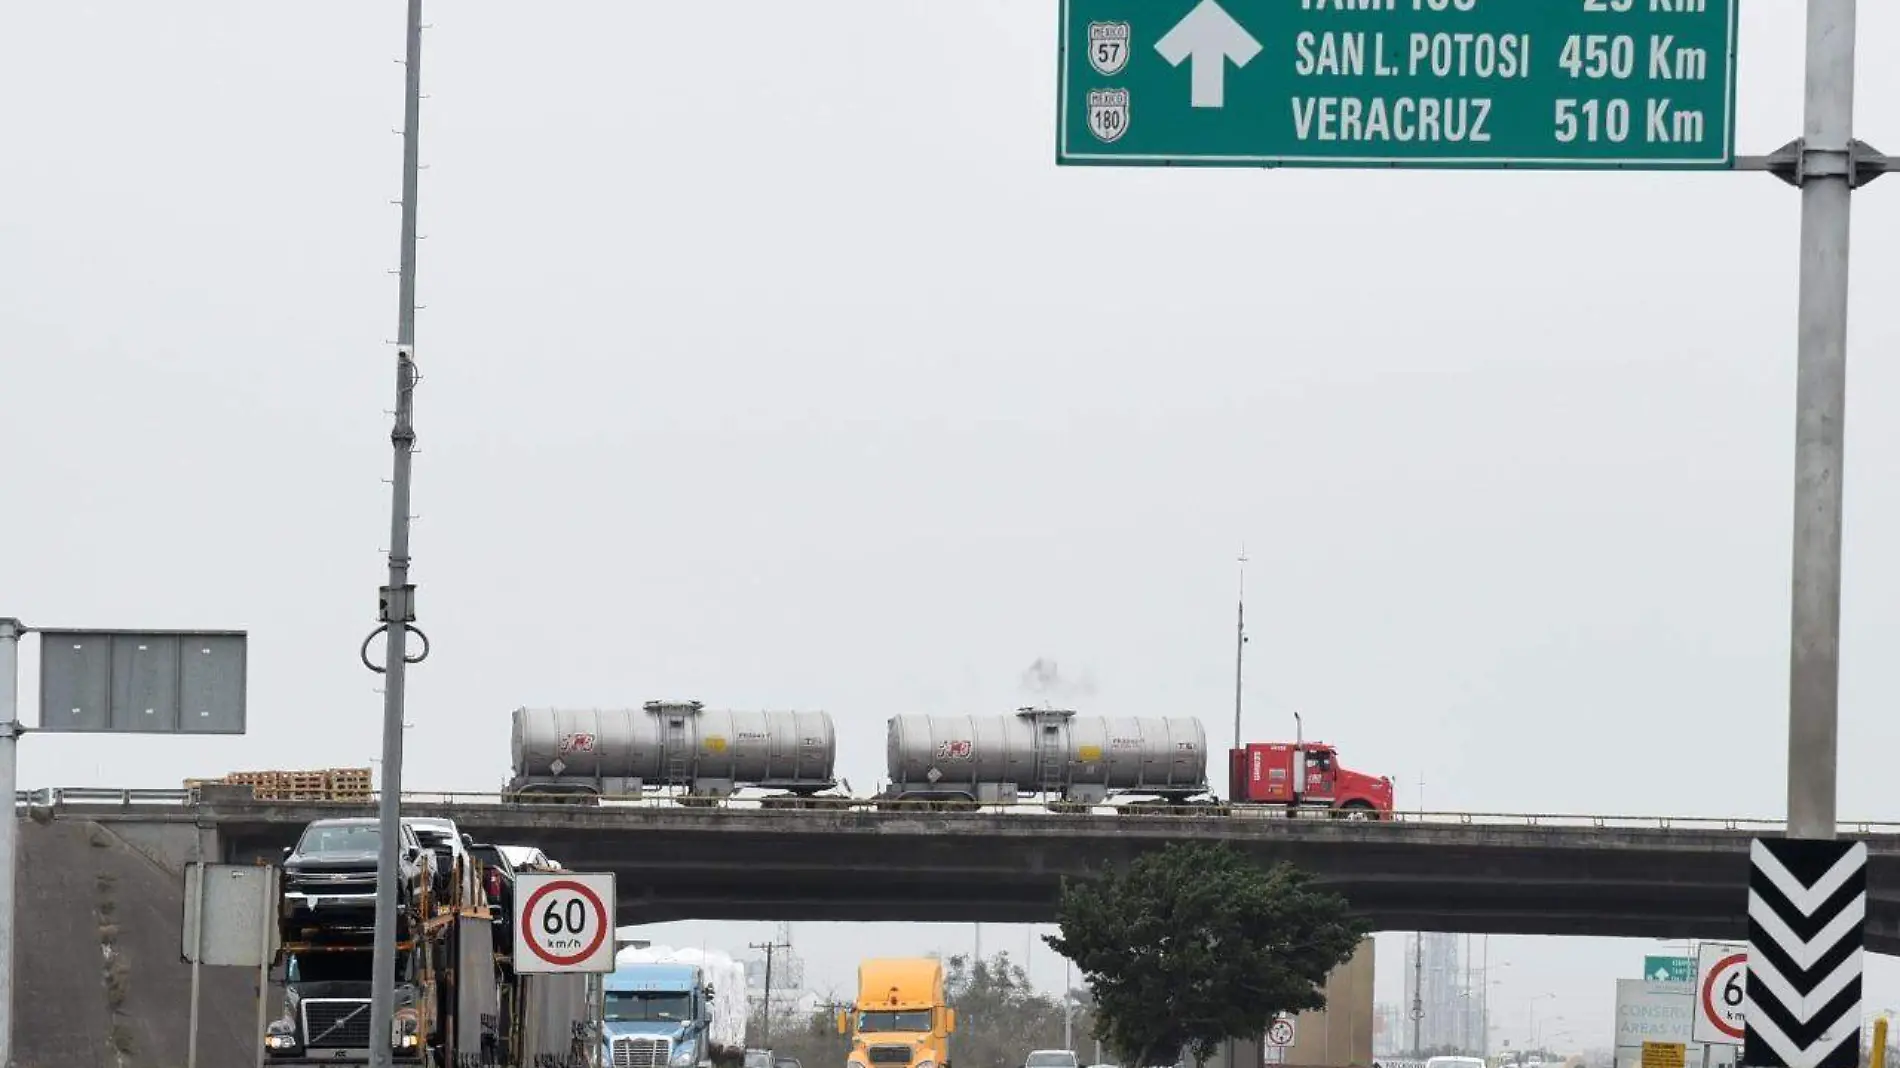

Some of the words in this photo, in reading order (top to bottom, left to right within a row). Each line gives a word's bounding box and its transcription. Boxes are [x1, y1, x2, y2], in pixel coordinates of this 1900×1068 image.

[1098, 43, 1120, 63] 57
[1295, 32, 1365, 76] SAN
[1375, 33, 1398, 76] L.
[1409, 32, 1529, 78] POTOSI
[1559, 35, 1634, 79] 450
[1649, 35, 1706, 80] Km
[1095, 110, 1120, 129] 180
[1292, 97, 1492, 142] VERACRUZ
[1555, 98, 1630, 142] 510
[1647, 98, 1704, 142] Km
[542, 898, 586, 935] 60
[547, 939, 581, 948] km/h
[1723, 971, 1744, 1007] 6
[1619, 1004, 1692, 1018] CONSERV
[1727, 1010, 1745, 1020] km
[1672, 1023, 1692, 1035] VE
